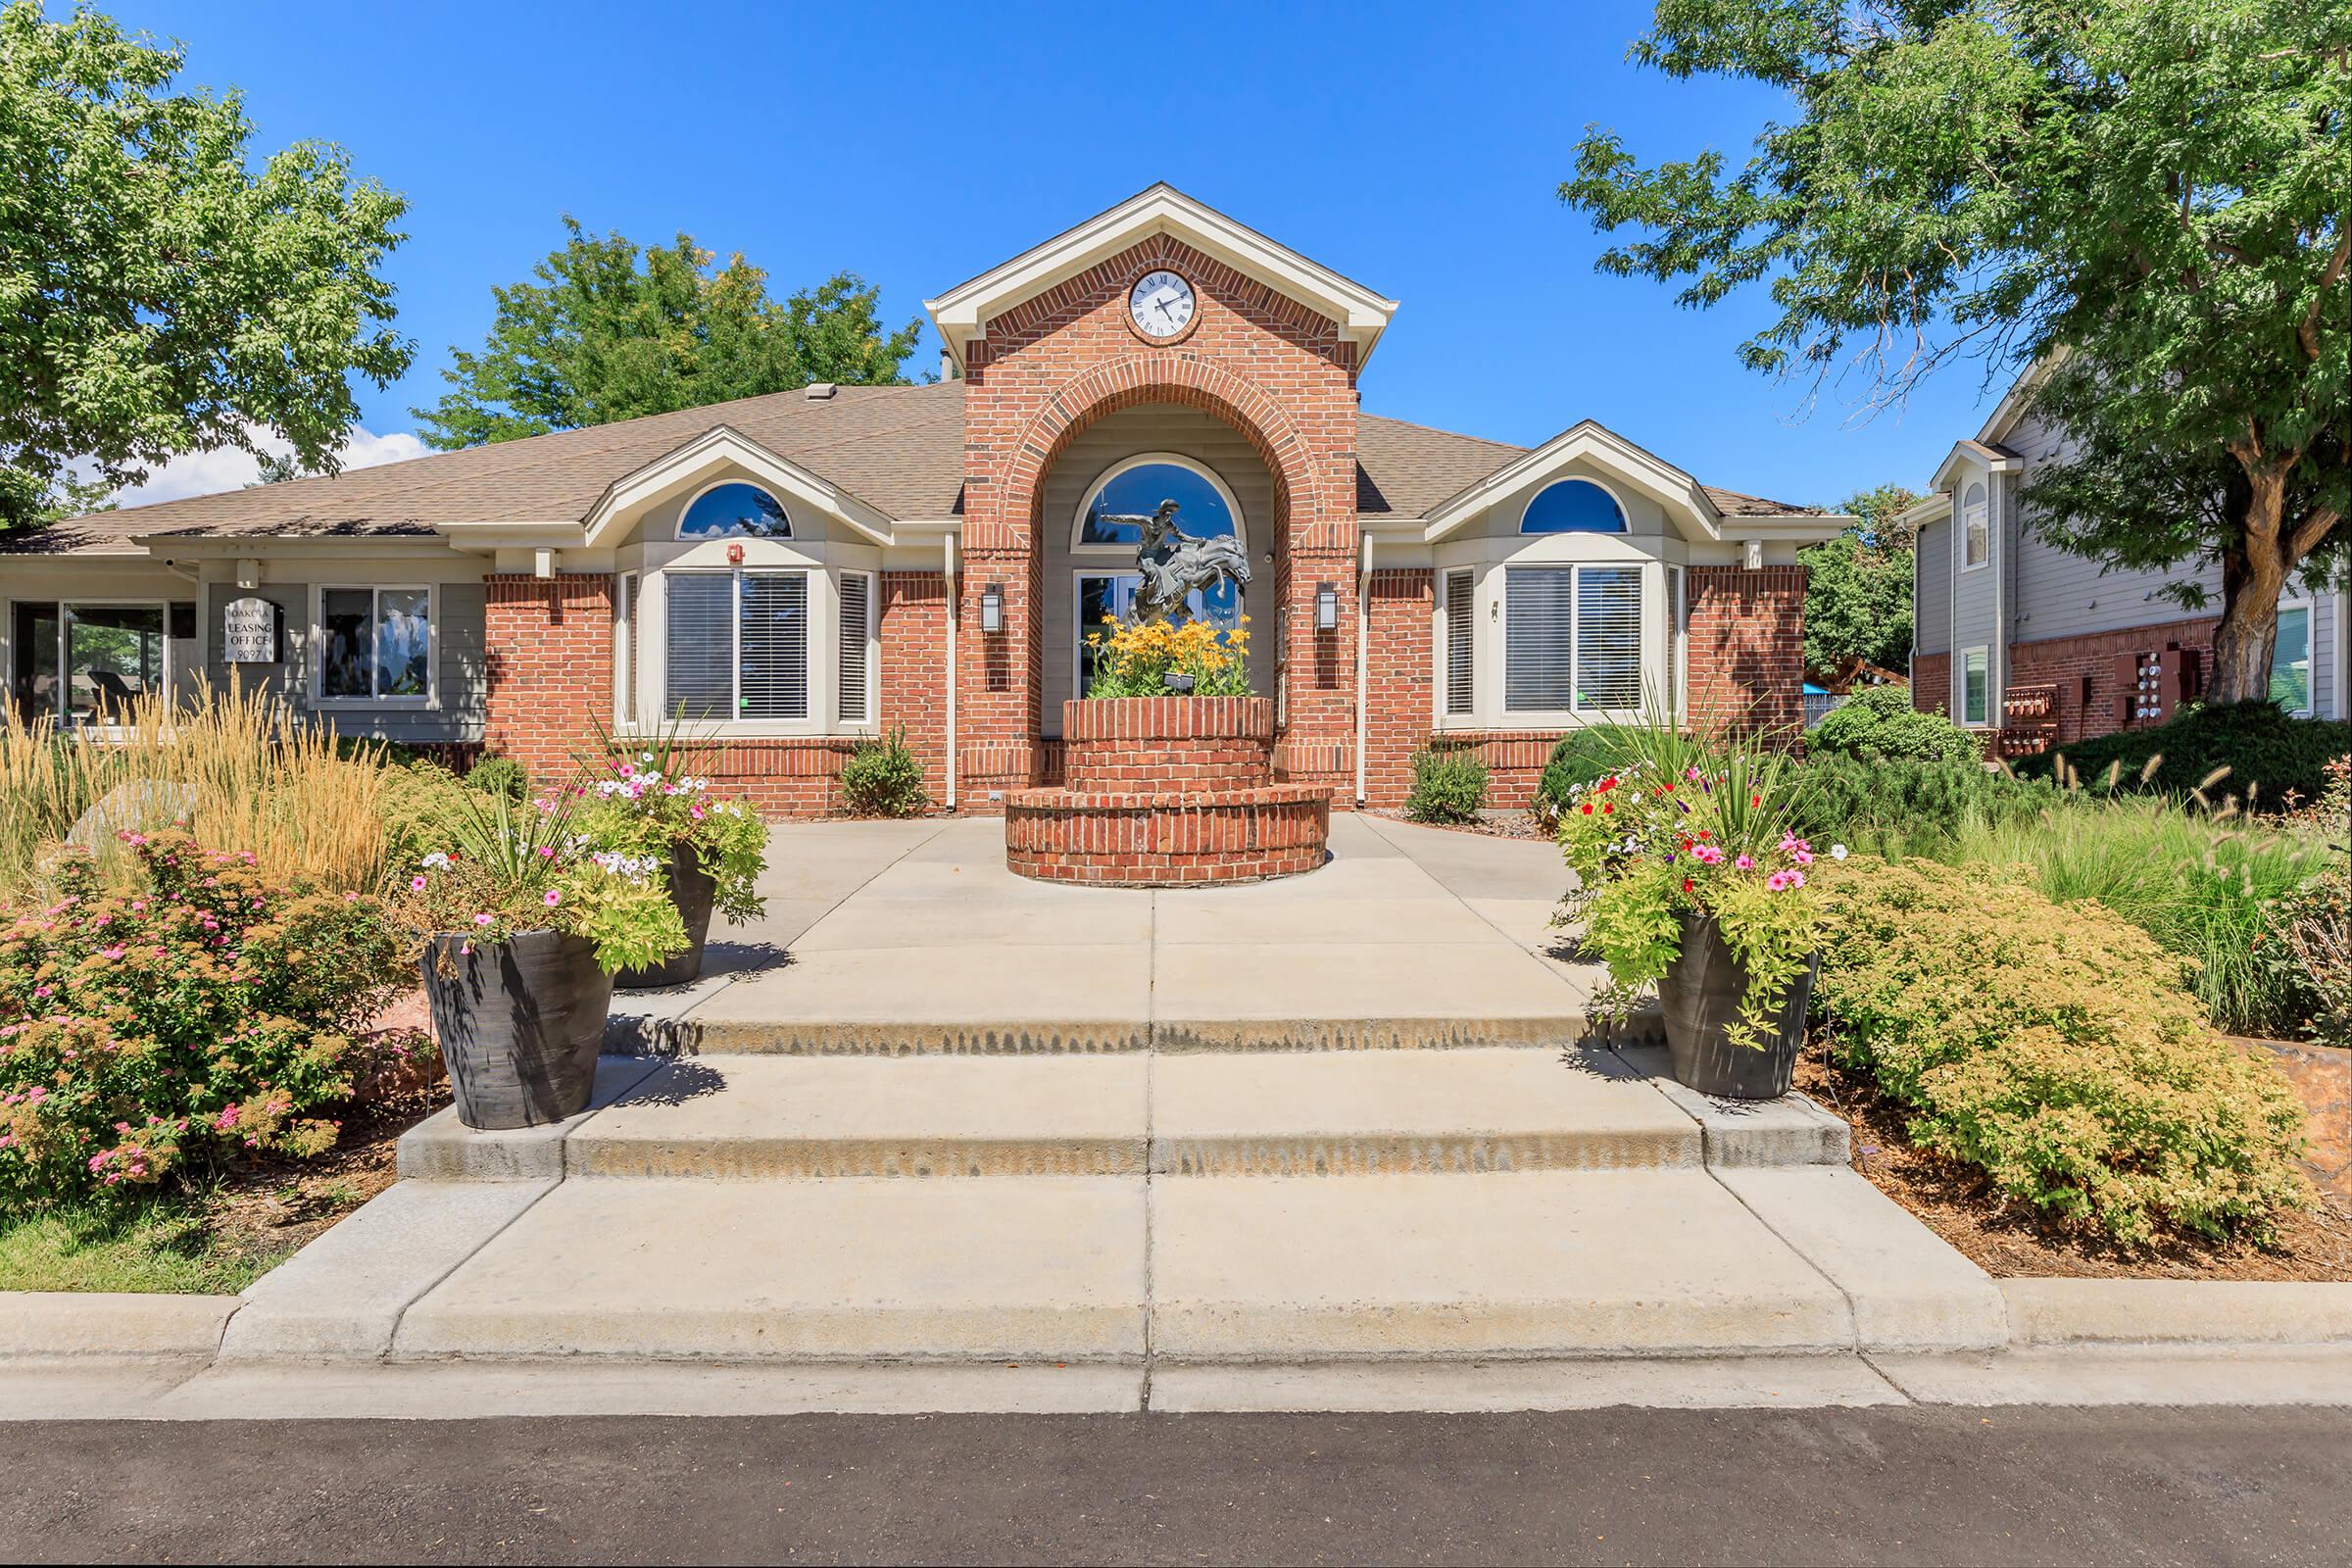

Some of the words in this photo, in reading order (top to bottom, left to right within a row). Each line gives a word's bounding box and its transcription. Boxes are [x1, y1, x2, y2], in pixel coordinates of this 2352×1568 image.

[228, 623, 272, 633] LEASING
[230, 635, 269, 645] OFFICE
[237, 650, 262, 660] 9097
